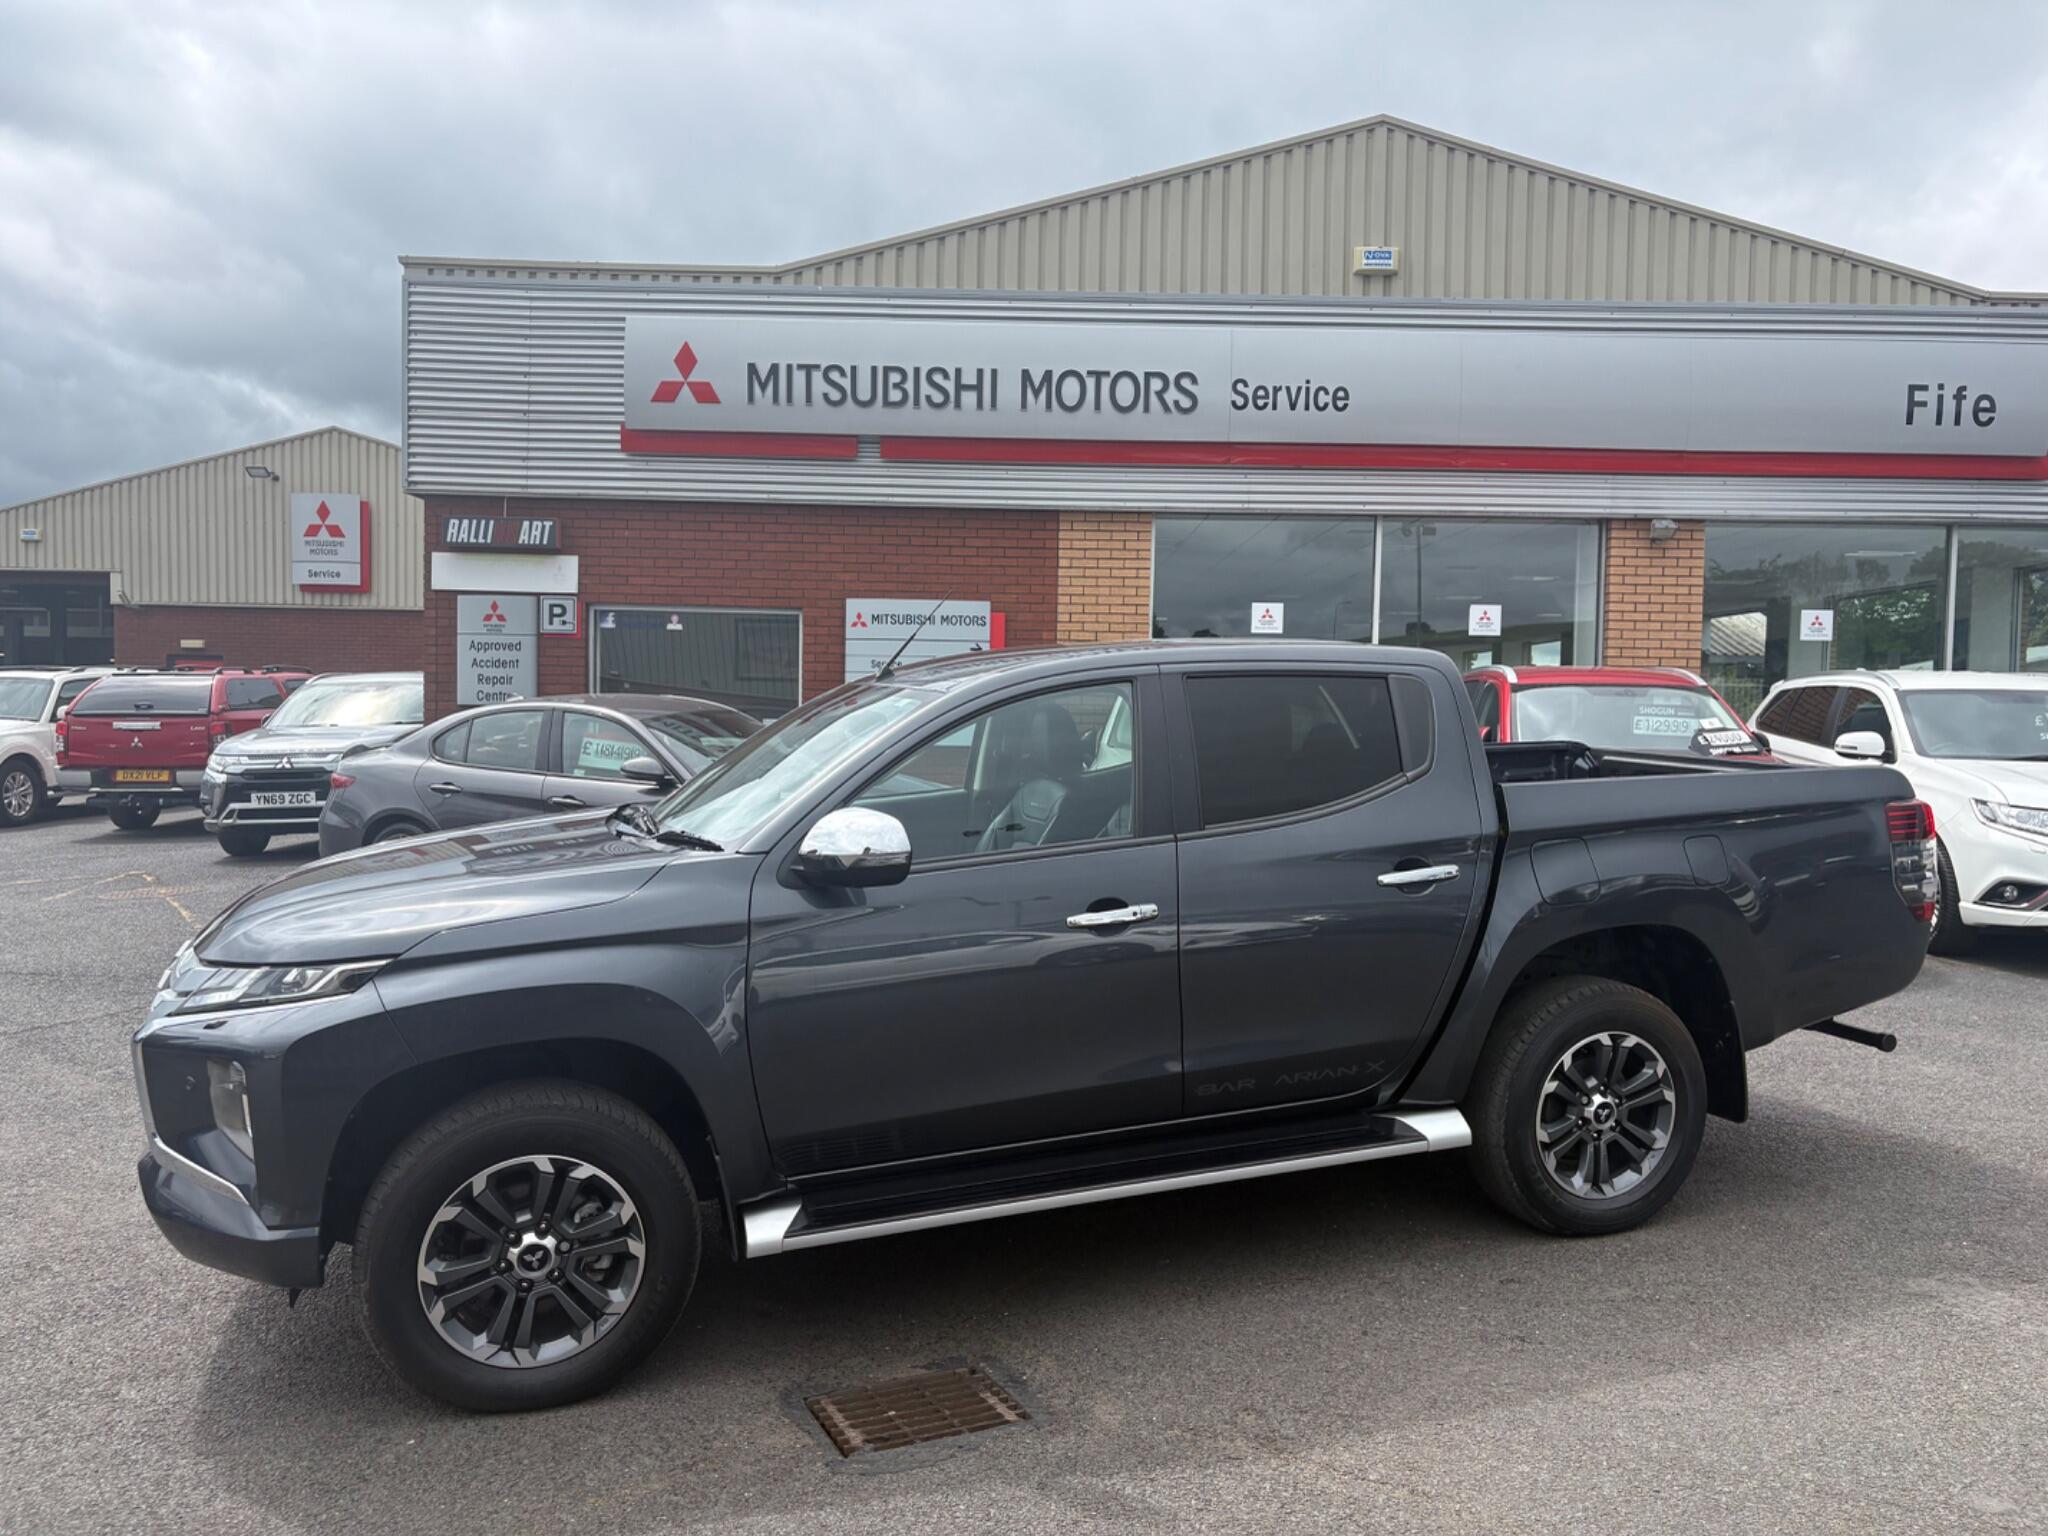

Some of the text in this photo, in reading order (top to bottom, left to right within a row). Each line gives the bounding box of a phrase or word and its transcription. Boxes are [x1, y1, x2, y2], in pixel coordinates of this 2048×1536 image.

[746, 361, 1351, 415] MITSUBISHI MOTORS Service
[1905, 382, 1997, 427] Fife
[446, 518, 553, 545] RALLI ART
[307, 568, 341, 578] Service
[548, 603, 568, 626] P
[871, 613, 987, 627] MITSUBISHI MOTORS
[469, 640, 522, 653] Approved
[471, 657, 519, 669] Accident
[476, 673, 513, 687] Repair
[256, 792, 311, 805] YN69 ZGC
